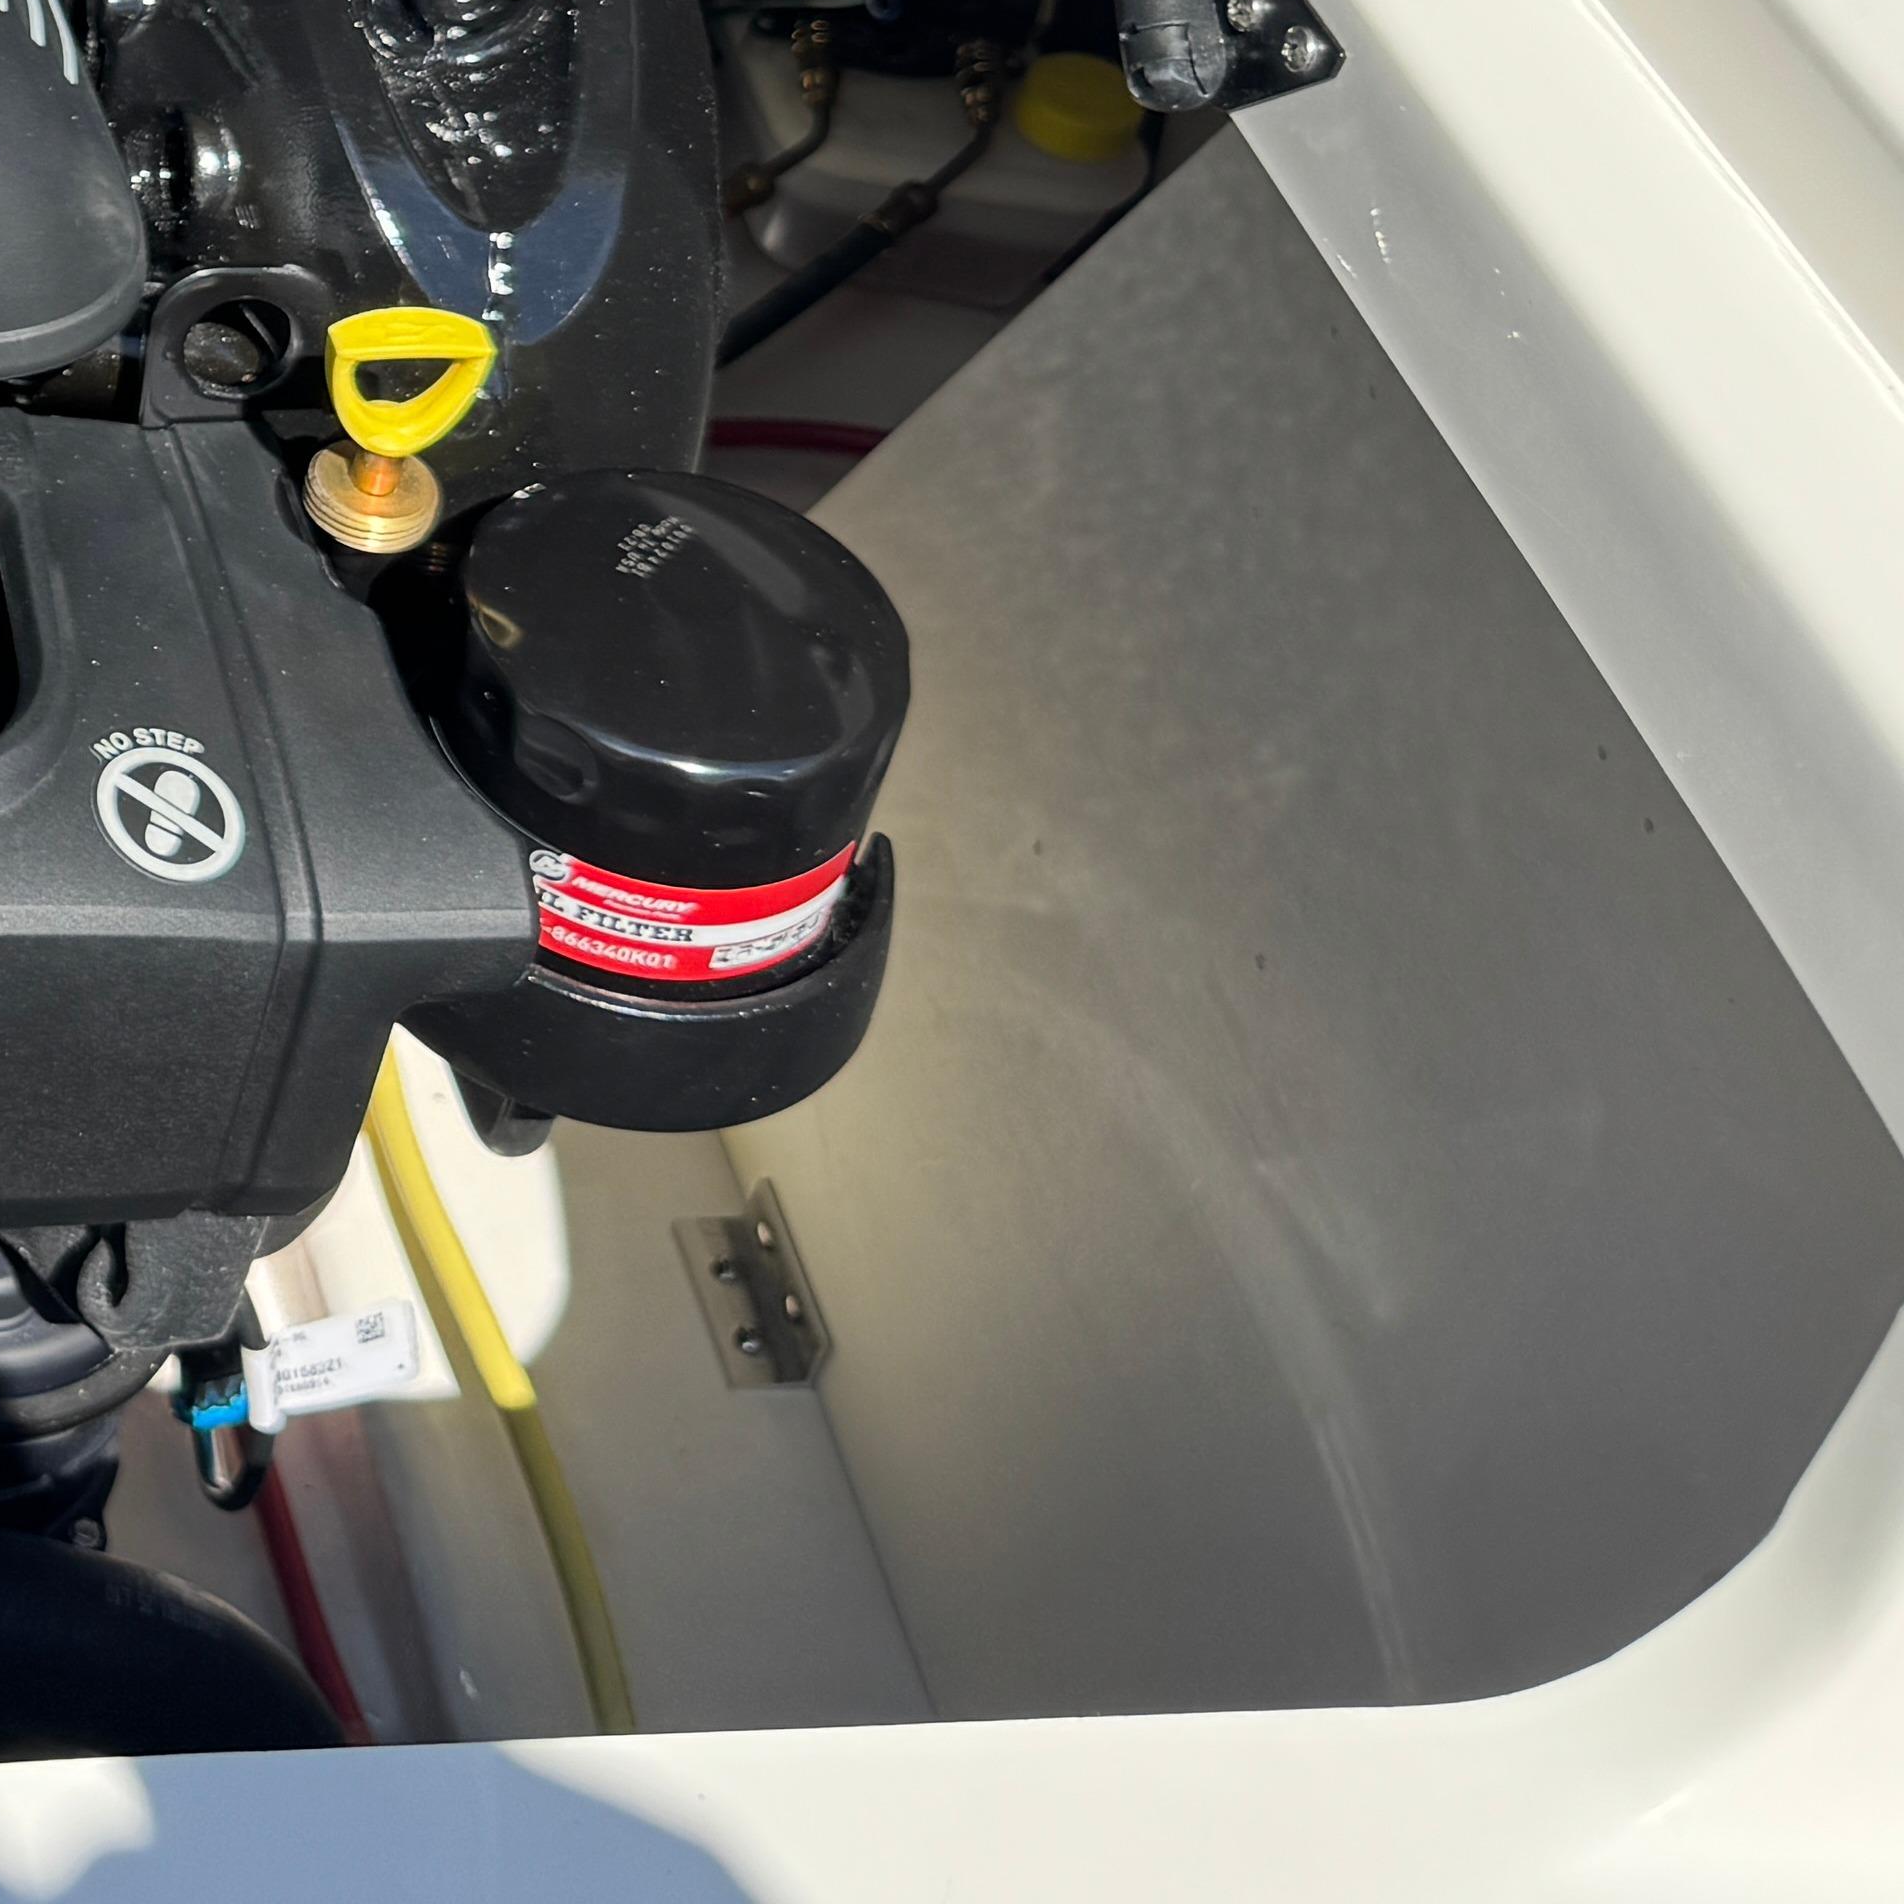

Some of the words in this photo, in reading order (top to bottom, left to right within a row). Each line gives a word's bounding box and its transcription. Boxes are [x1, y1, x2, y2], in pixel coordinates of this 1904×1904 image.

[94, 732, 134, 760] NO
[133, 728, 205, 753] STEP
[572, 876, 699, 913] MERCURY
[574, 904, 693, 942] FILTER
